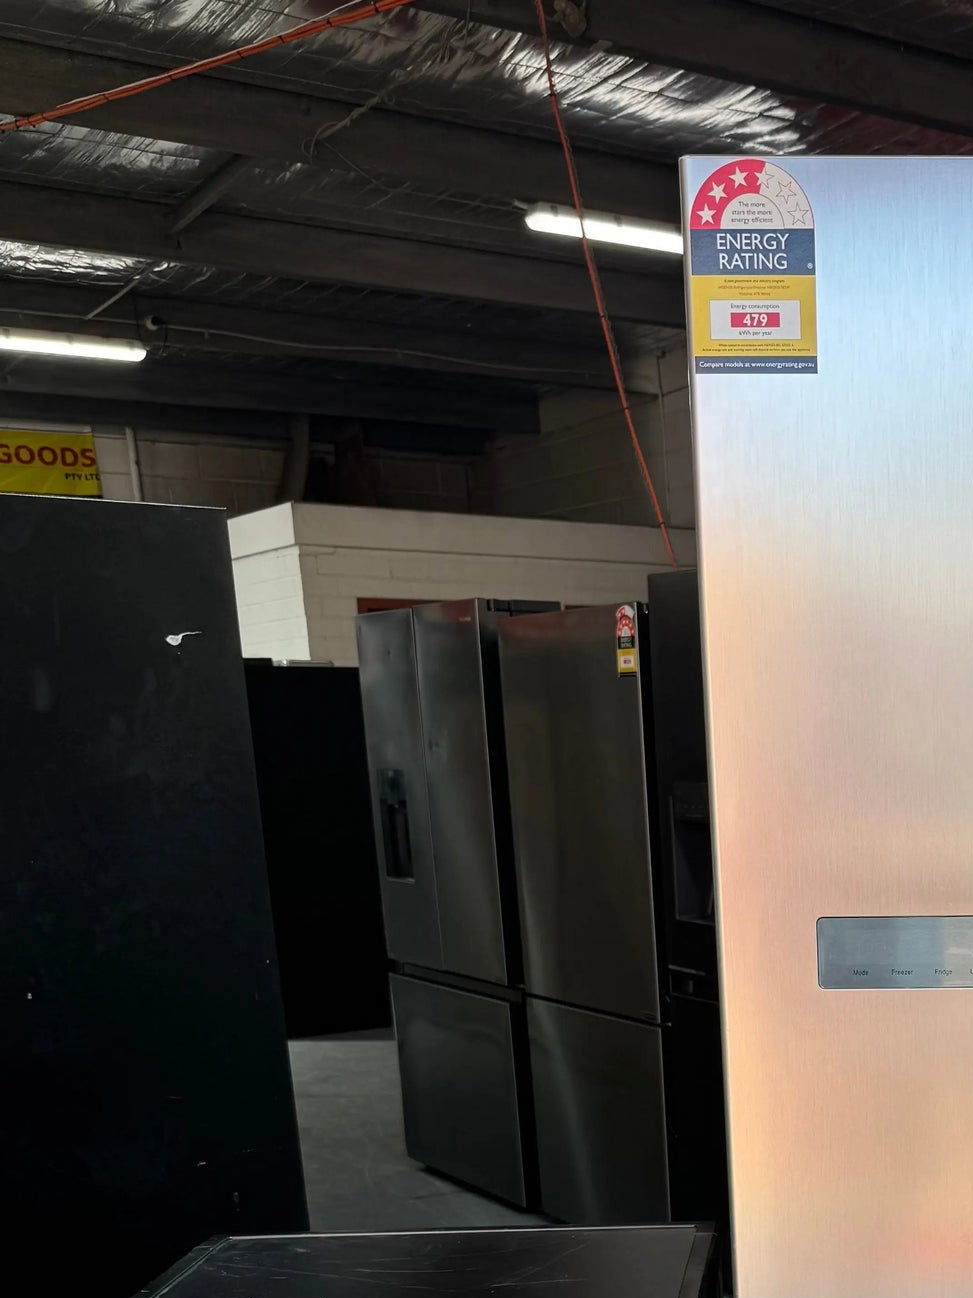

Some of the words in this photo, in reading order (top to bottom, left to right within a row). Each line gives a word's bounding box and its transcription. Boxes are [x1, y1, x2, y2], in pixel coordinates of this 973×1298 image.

[717, 233, 789, 249] ENERGY
[719, 253, 787, 269] RATING
[743, 314, 767, 326] 479
[0, 444, 97, 468] GOODS
